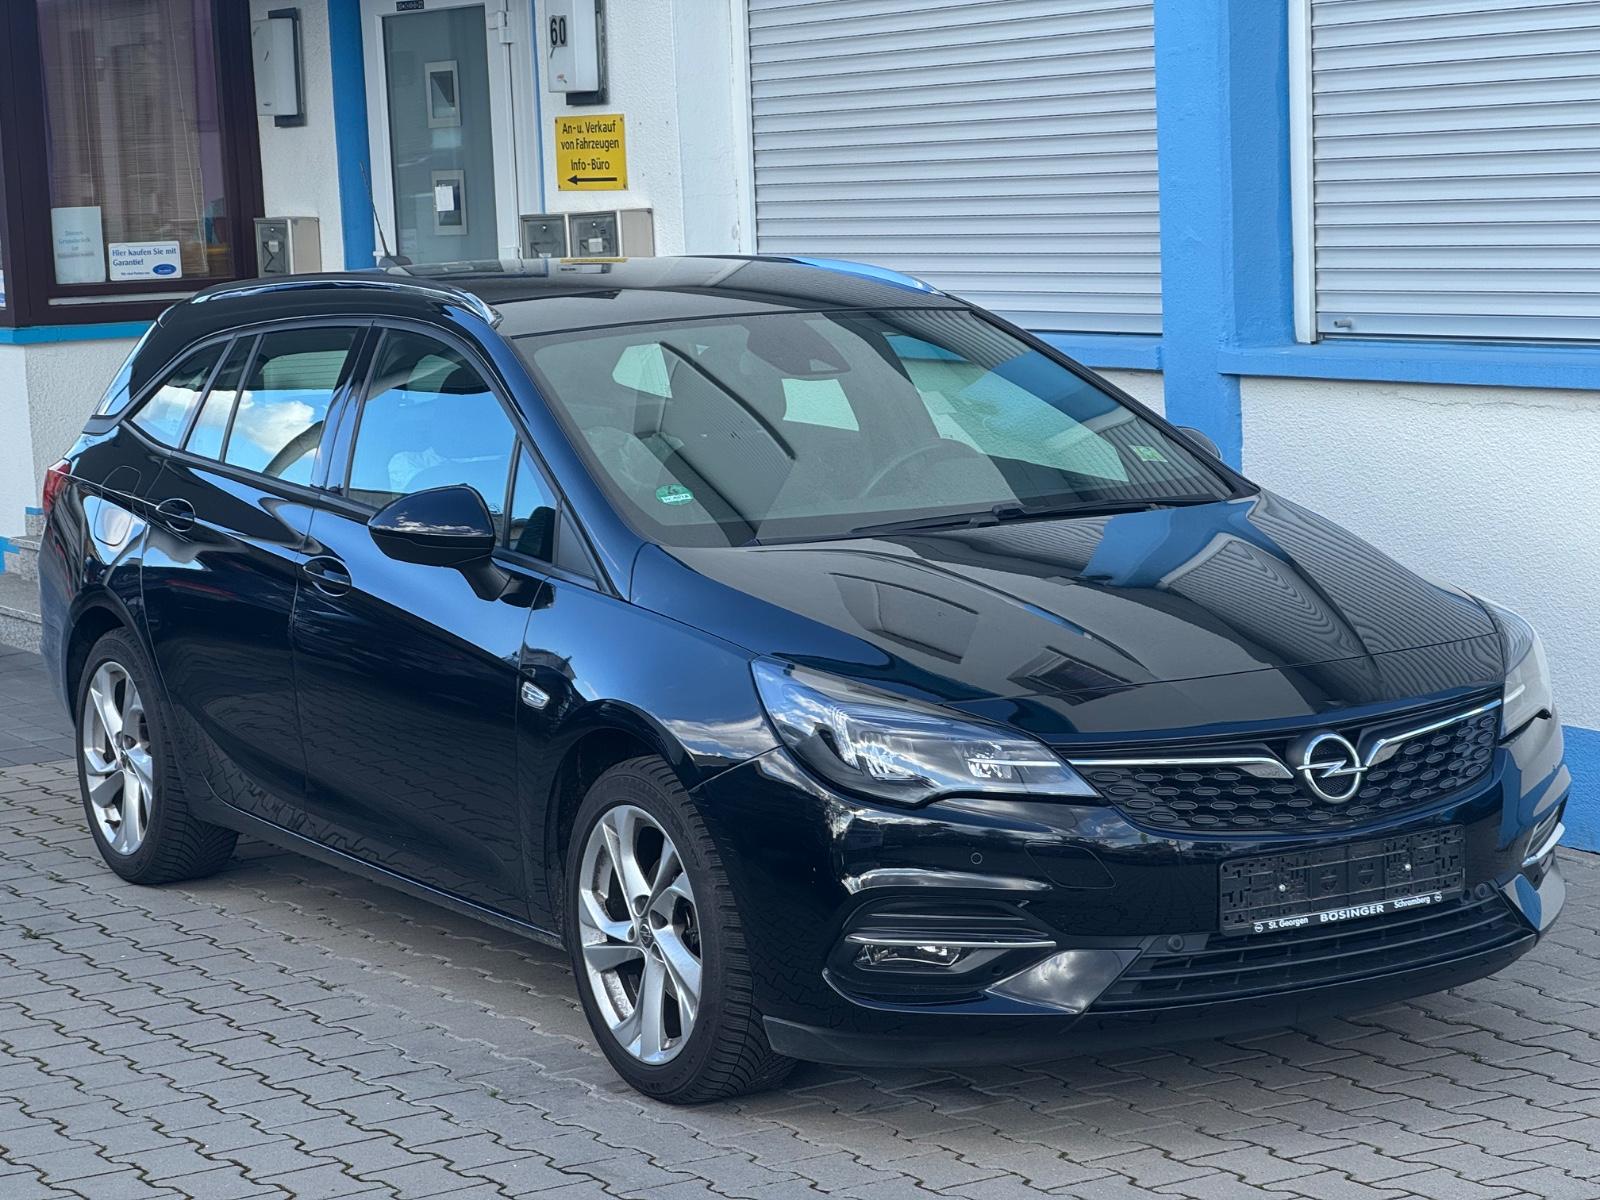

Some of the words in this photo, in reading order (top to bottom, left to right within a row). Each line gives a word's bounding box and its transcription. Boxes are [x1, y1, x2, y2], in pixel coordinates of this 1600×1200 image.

[550, 17, 566, 45] 60
[585, 120, 616, 133] Verkauf
[560, 141, 574, 150] von
[576, 137, 619, 152] Fahrzeugen
[128, 248, 152, 256] kaufen
[153, 247, 164, 255] Sie
[165, 247, 177, 255] mit
[112, 258, 144, 266] Garantie!
[1279, 917, 1309, 928] Georgen
[1394, 896, 1431, 909] Schramberg
